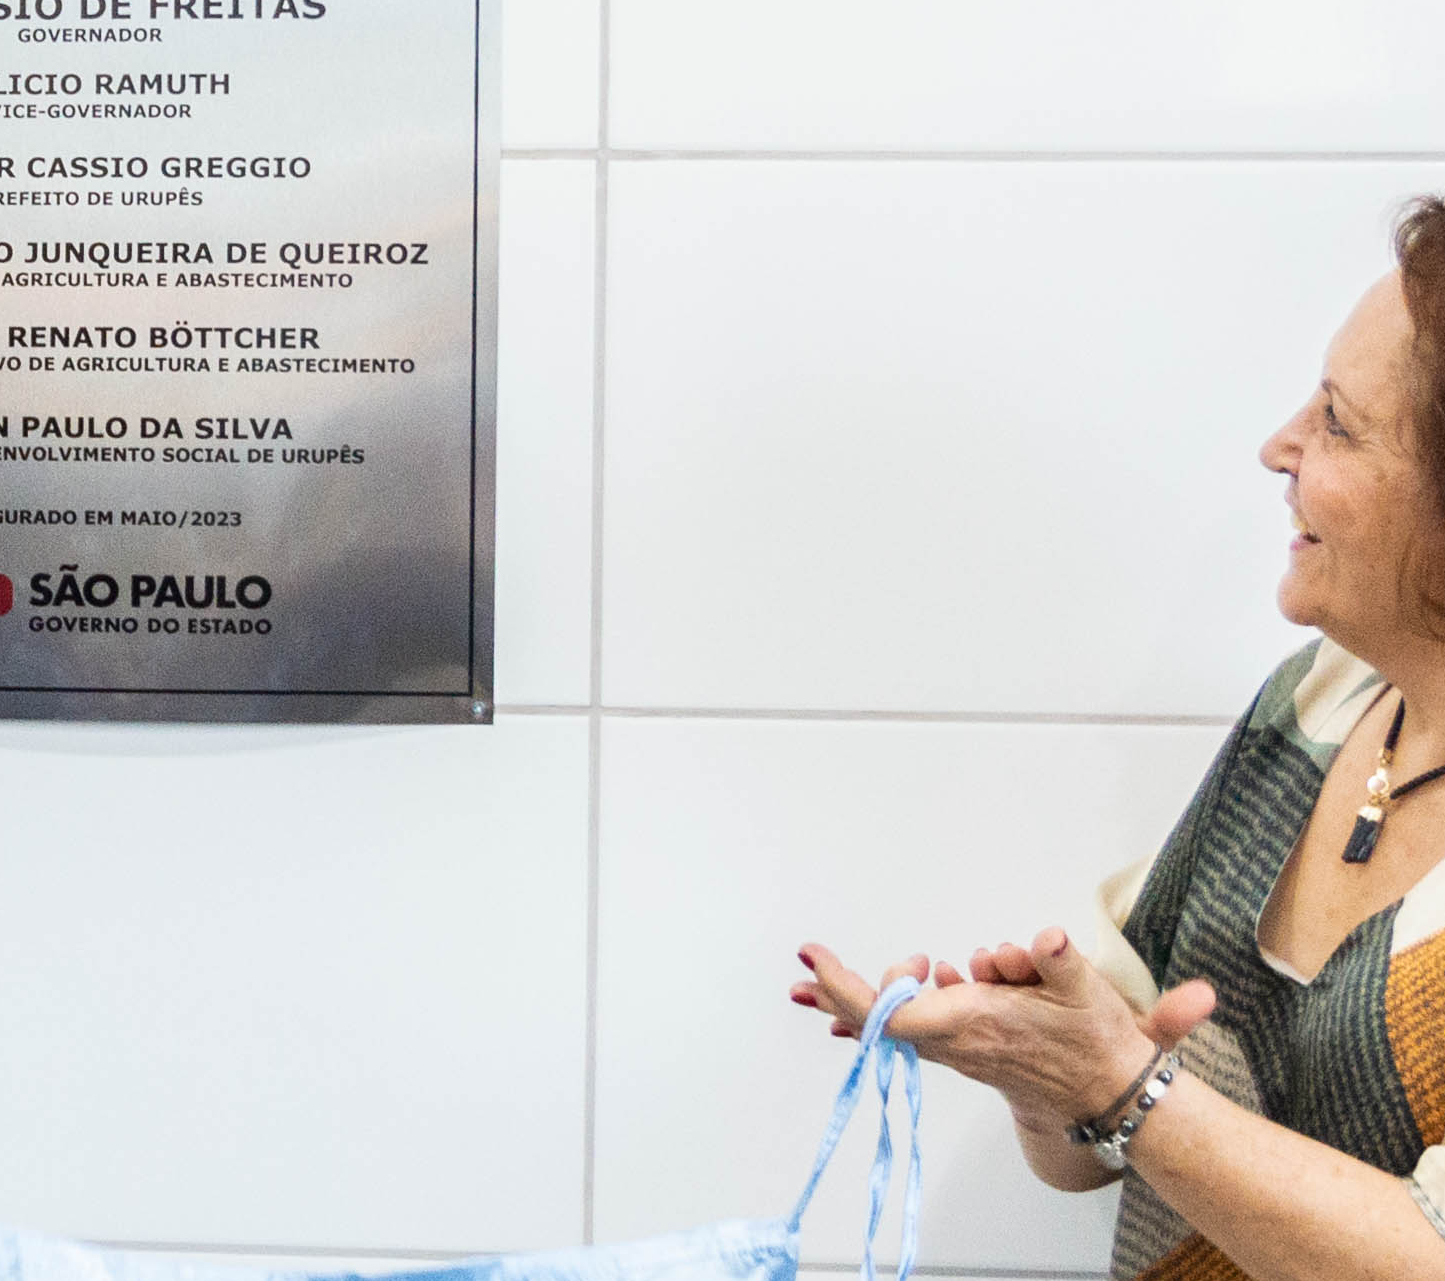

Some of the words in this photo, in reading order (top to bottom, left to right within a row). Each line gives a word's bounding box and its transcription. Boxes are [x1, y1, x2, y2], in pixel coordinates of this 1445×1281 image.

[17, 27, 163, 44] GOVERNADOR
[94, 72, 230, 96] RAMUTH
[26, 155, 149, 179] CASSIO
[160, 156, 312, 179] GREGGIO
[87, 190, 114, 207] DE
[120, 186, 204, 207] URUPÊS
[23, 241, 214, 270] JUNQUEIRA
[226, 241, 267, 265] DE
[278, 241, 429, 271] QUEIROZ
[0, 271, 150, 288] AGRICULTURA
[156, 272, 168, 288] E
[174, 272, 354, 289] ABASTECIMENTO
[7, 325, 138, 349] RENATO
[149, 319, 321, 350] BÖTTCHER
[28, 356, 56, 372] DE
[61, 356, 211, 373] AGRICULTURA
[217, 357, 230, 373] E
[235, 357, 416, 375] ABASTECIMENTO
[21, 415, 129, 440] PAULO
[139, 416, 184, 440] DA
[194, 416, 294, 441] SILVA
[162, 447, 241, 464] SOCIAL
[247, 448, 275, 464] DE
[281, 443, 365, 465] URUPÊS
[84, 509, 114, 526] EM
[120, 510, 242, 529] MAIO/2023
[29, 563, 120, 608] SÃO
[130, 574, 273, 610] PAULO
[28, 616, 139, 635] GOVERNO
[147, 617, 180, 635] DO
[187, 618, 273, 636] ESTADO
